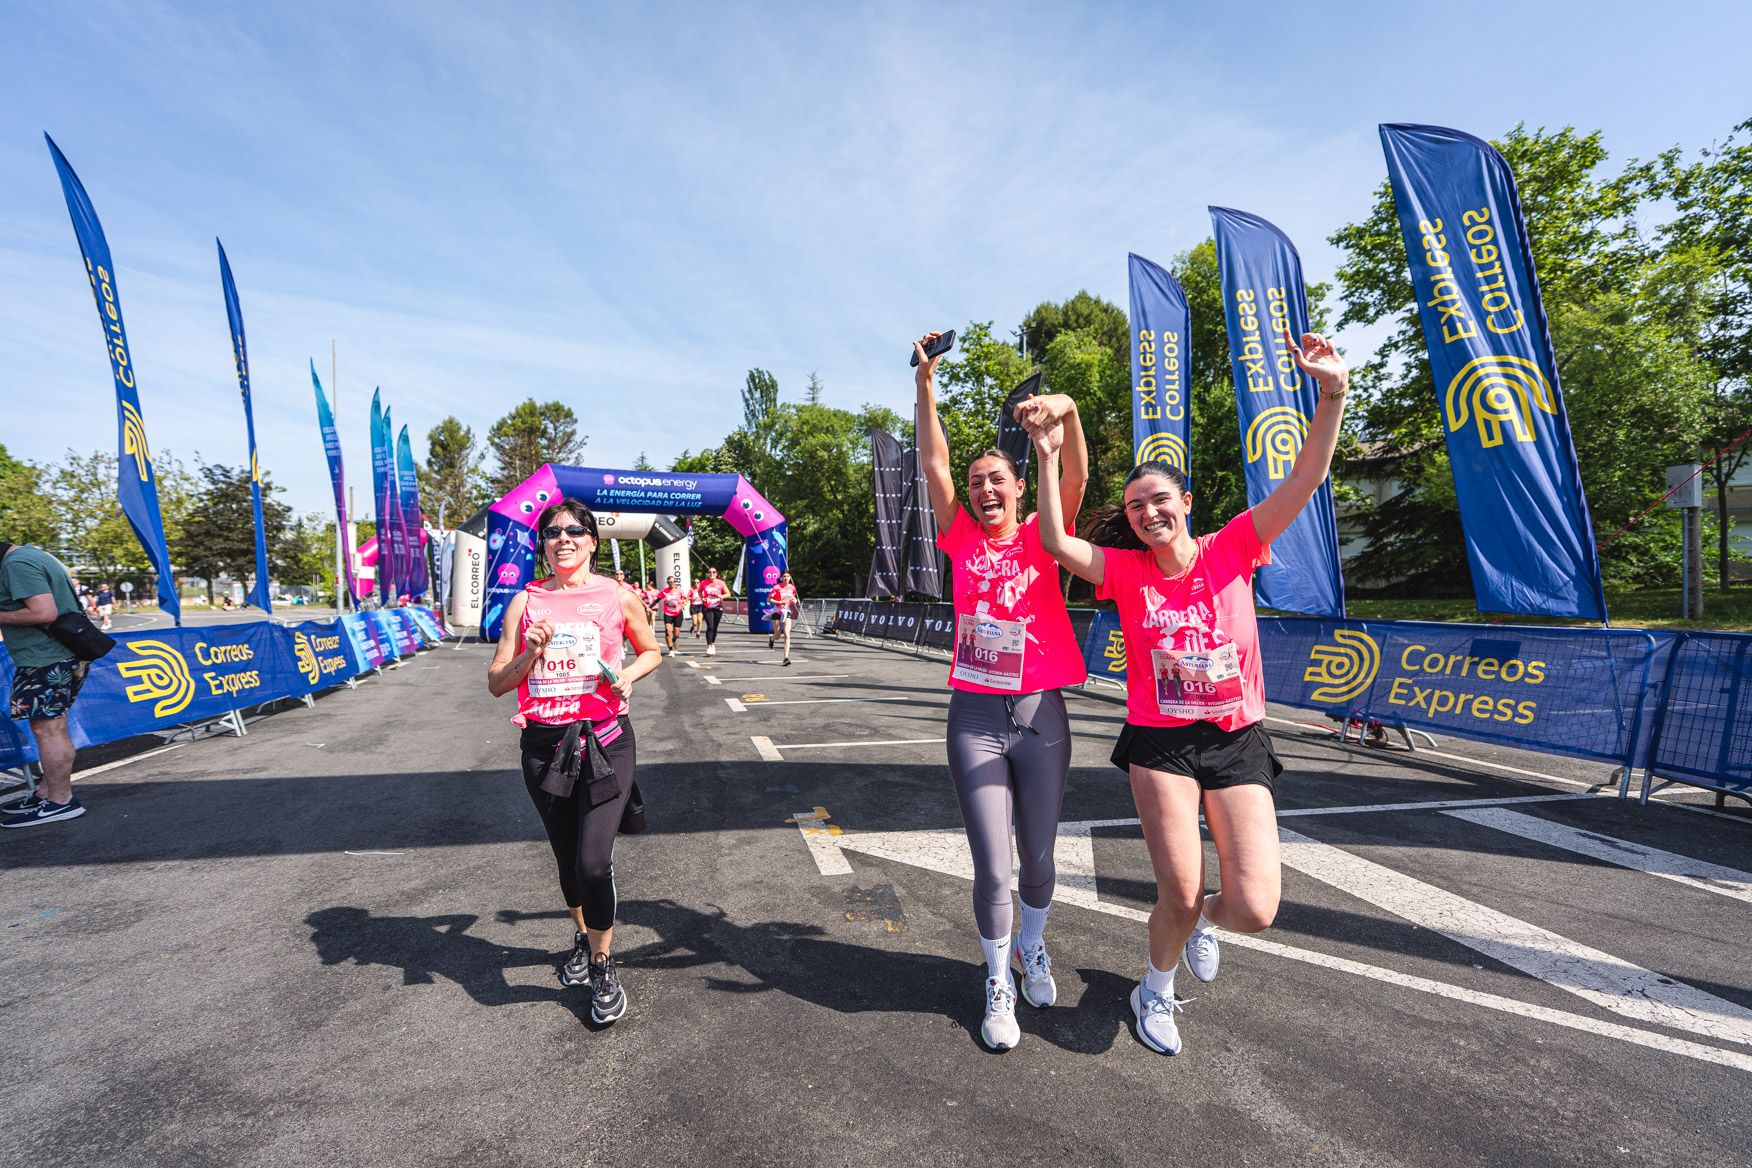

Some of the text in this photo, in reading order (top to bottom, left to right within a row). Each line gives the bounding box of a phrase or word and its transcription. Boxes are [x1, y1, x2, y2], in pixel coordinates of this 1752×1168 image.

[609, 490, 645, 498] ENERGÍA
[646, 491, 668, 499] PARA
[670, 492, 701, 500] CORRER
[673, 552, 680, 564] EL
[471, 552, 480, 609] EL CORREO
[838, 610, 953, 633] VOLVO VOLVO VOL
[311, 634, 340, 652] Correos
[194, 642, 254, 666] Correos
[975, 647, 999, 662] 016
[1401, 644, 1547, 684] Correos
[318, 655, 347, 676] Express
[547, 659, 576, 671] 016
[203, 670, 260, 697] Express
[1183, 680, 1217, 694] 016
[1388, 677, 1537, 724] Express
